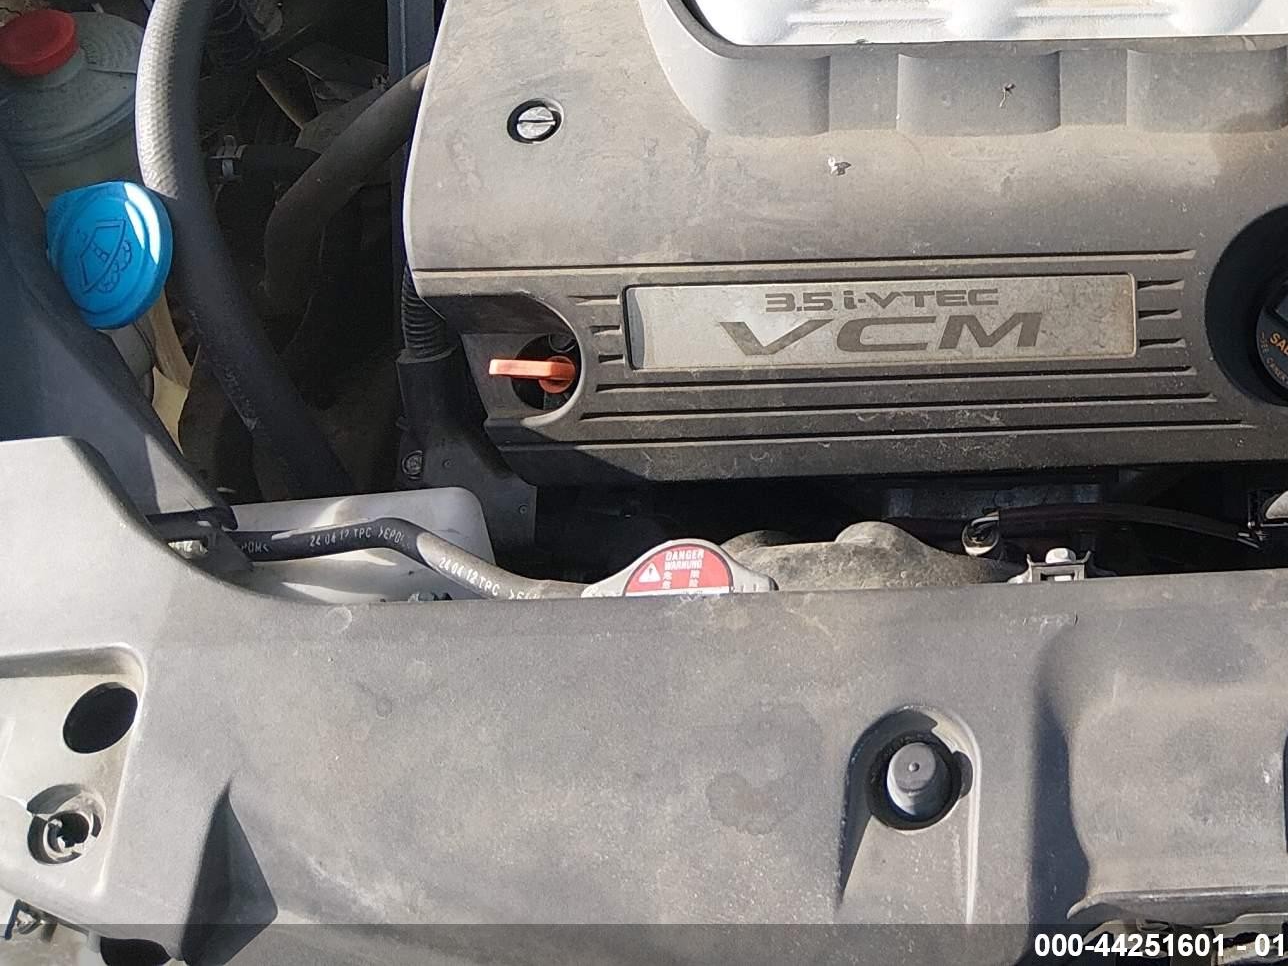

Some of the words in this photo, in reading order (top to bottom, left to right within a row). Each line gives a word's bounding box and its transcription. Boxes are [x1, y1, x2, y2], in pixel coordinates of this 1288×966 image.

[764, 291, 834, 313] 3.5
[843, 288, 999, 310] i-VTEC
[719, 312, 1044, 356] VCM
[353, 526, 373, 539] TPC
[665, 549, 705, 561] DANGER
[478, 575, 500, 596] TPC
